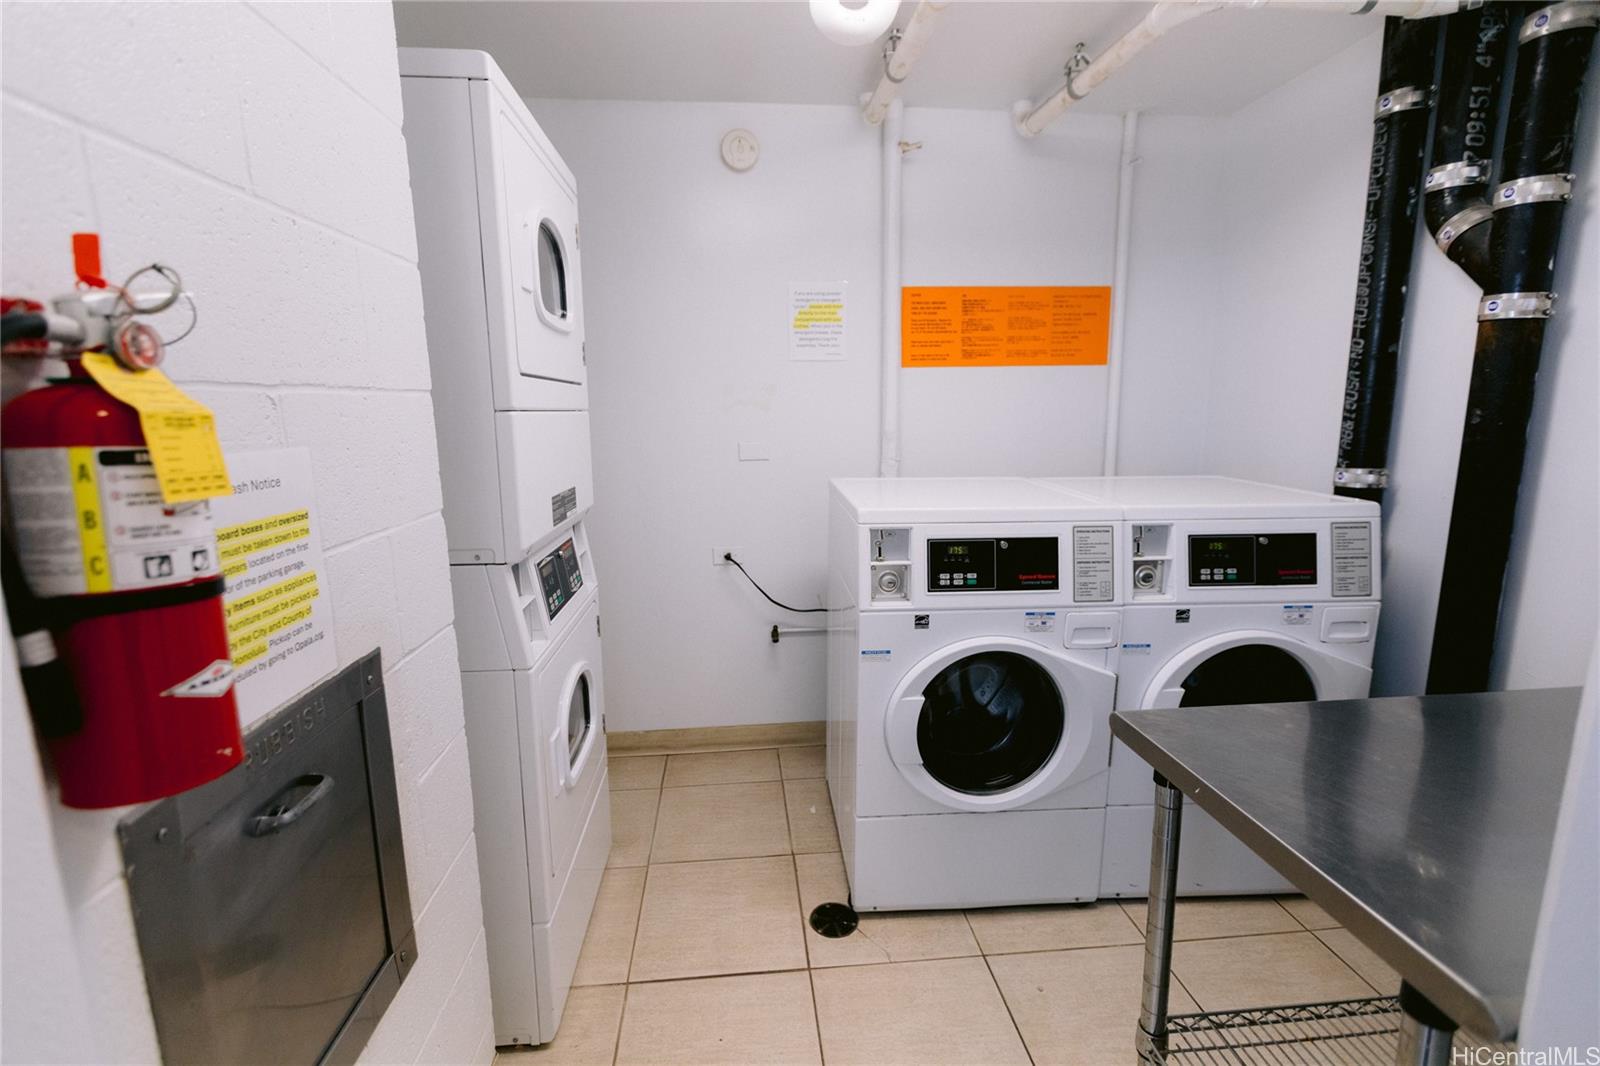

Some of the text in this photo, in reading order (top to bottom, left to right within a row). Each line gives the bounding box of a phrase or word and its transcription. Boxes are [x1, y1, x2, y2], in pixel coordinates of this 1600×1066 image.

[1465, 84, 1493, 147] 09:51
[77, 464, 91, 483] A
[250, 477, 281, 492] Notice
[83, 510, 97, 530] B
[240, 523, 263, 537] boxes
[264, 519, 278, 531] and
[278, 511, 309, 526] oversized
[243, 543, 253, 553] be
[274, 531, 292, 543] down
[291, 530, 300, 539] to
[299, 527, 310, 537] the
[89, 556, 103, 576] C
[248, 553, 275, 568] located
[275, 551, 284, 560] on
[284, 546, 297, 557] the
[296, 542, 309, 553] first
[234, 580, 244, 591] of
[244, 576, 257, 587] the
[257, 567, 284, 585] parking
[232, 598, 256, 613] items
[256, 590, 274, 603] such
[273, 586, 283, 596] as
[283, 573, 317, 592] appliances
[261, 604, 280, 618] must
[279, 600, 290, 610] be
[289, 591, 311, 608] picked
[311, 588, 320, 598] up
[238, 634, 252, 646] the
[252, 626, 268, 641] City
[268, 619, 282, 633] and
[282, 609, 305, 627] County
[304, 604, 312, 616] of
[268, 631, 292, 648] Pickup
[291, 626, 304, 638] can
[304, 622, 313, 631] be
[257, 660, 267, 672] by
[268, 651, 287, 667] going
[286, 647, 294, 656] to
